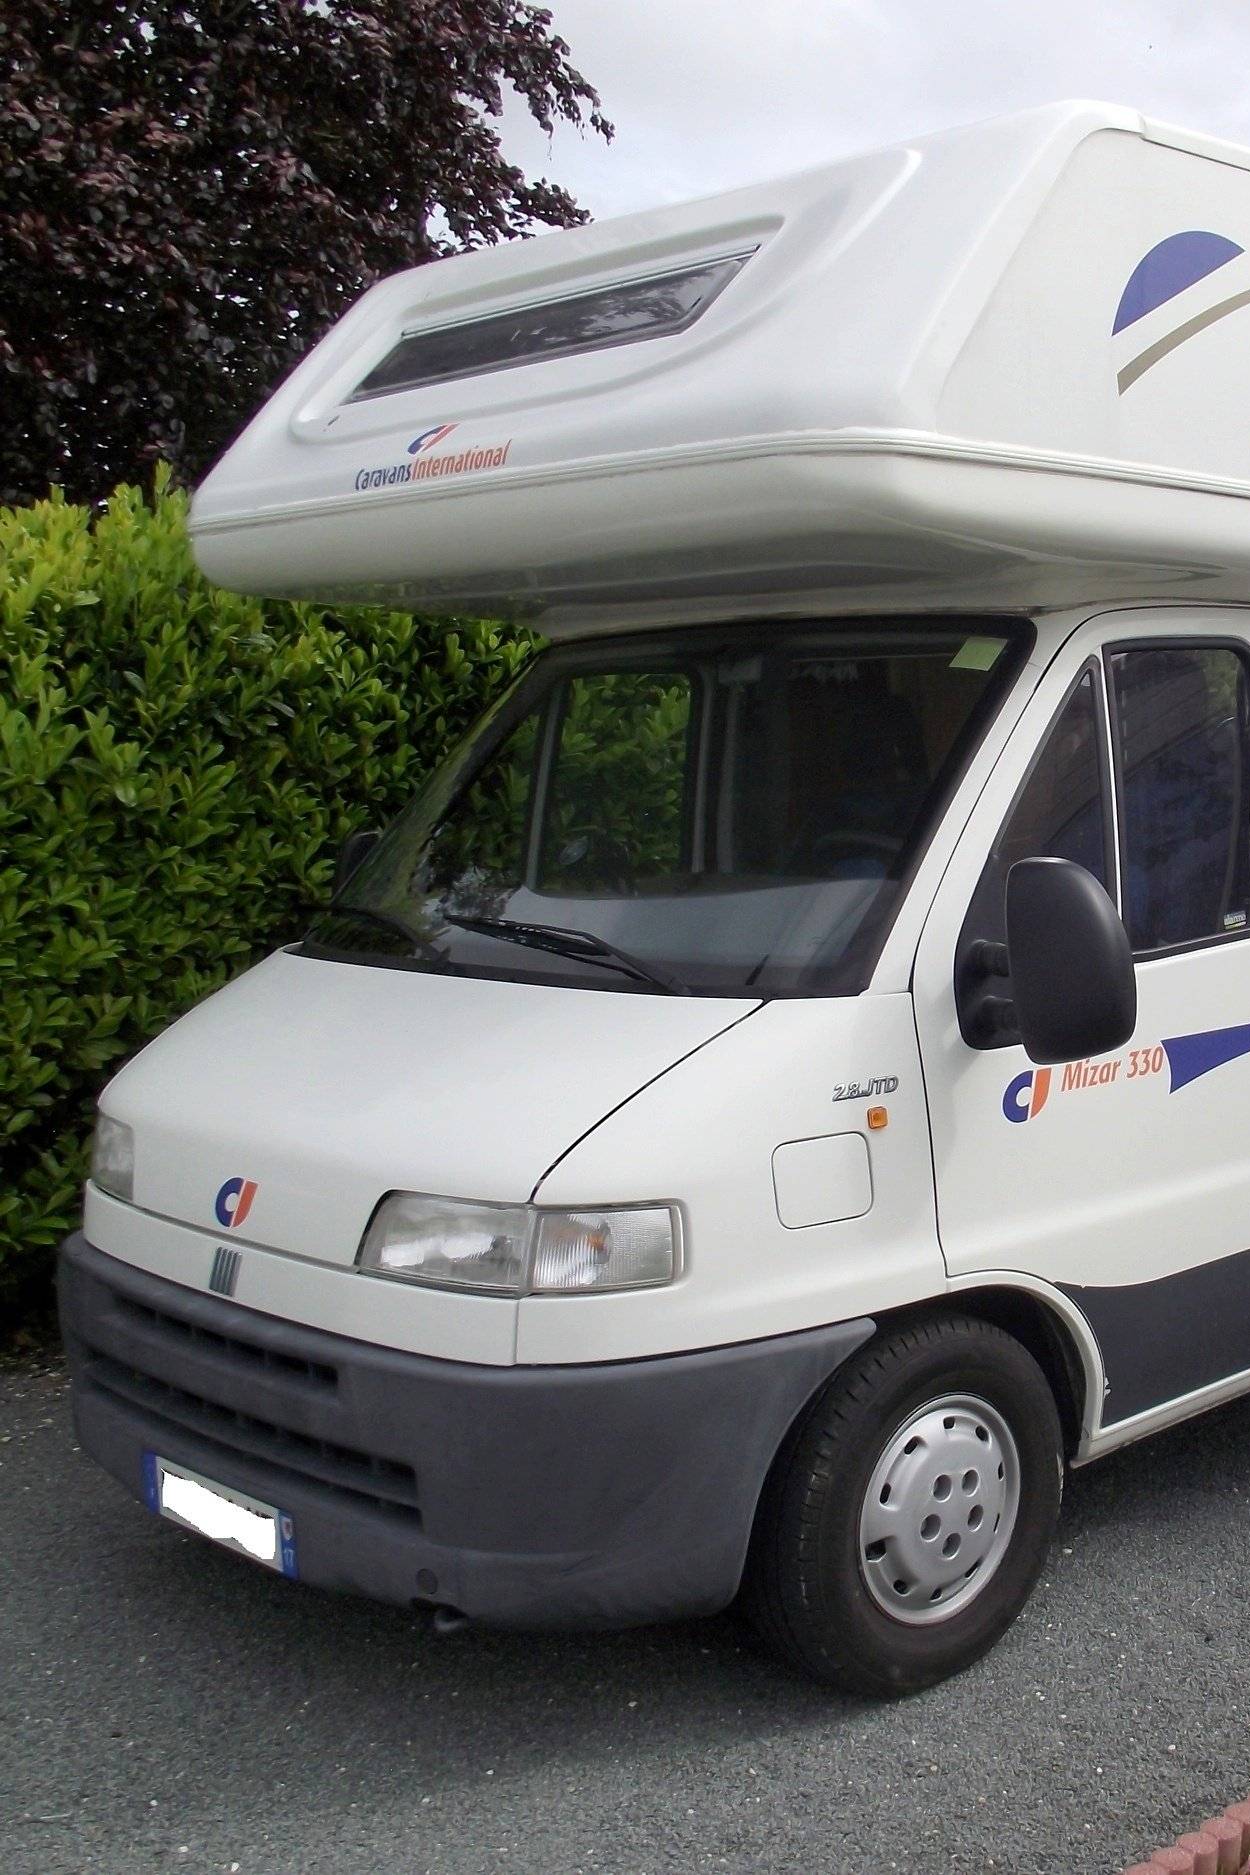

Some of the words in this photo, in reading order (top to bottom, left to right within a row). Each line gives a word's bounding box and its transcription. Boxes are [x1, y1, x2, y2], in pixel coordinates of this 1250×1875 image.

[355, 463, 411, 491] Caravans
[411, 439, 513, 481] International
[1061, 1057, 1122, 1092] Mizar
[1126, 1045, 1164, 1079] 330
